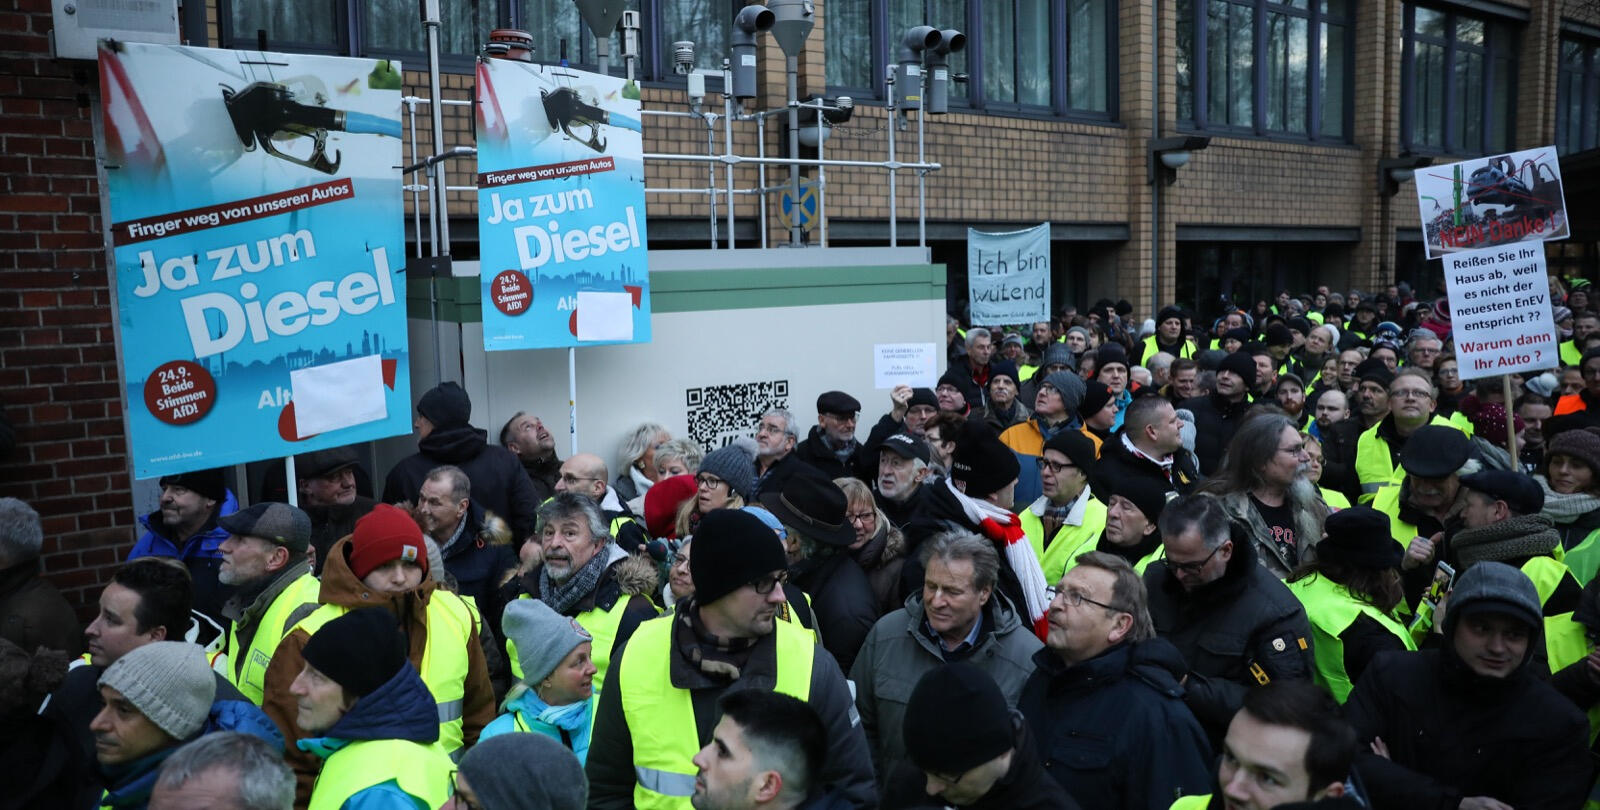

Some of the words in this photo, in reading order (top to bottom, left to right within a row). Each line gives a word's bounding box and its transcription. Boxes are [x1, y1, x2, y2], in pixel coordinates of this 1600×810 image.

[486, 171, 516, 184] Finger
[517, 170, 537, 180] weg
[538, 167, 554, 177] von
[589, 160, 612, 170] Autos
[127, 219, 182, 238] Finger
[184, 209, 220, 226] weg
[221, 206, 251, 220] von
[254, 193, 310, 214] unseren
[311, 184, 349, 201] Autos
[487, 193, 525, 224] Ja
[529, 188, 594, 217] zum
[514, 206, 641, 270] Diesel
[1440, 223, 1486, 249] NEIN
[1490, 216, 1545, 241] Danke
[1550, 211, 1556, 230] !
[133, 250, 200, 297] Ja
[206, 229, 316, 281] zum
[977, 248, 1008, 275] Ich
[1016, 248, 1047, 272] bin
[1453, 255, 1495, 269] Reißen
[1498, 252, 1516, 263] Sie
[1519, 248, 1535, 259] Ihr
[499, 273, 519, 285] 24.9.
[1455, 274, 1485, 285] Haus
[1488, 270, 1507, 280] ab,
[1513, 263, 1538, 276] weil
[497, 292, 528, 304] Stimmen
[501, 283, 520, 294] Beide
[972, 278, 1045, 303] wütend
[1464, 290, 1478, 300] es
[1480, 284, 1510, 297] nicht
[1513, 281, 1534, 292] der
[180, 247, 396, 359] Diesel
[507, 300, 522, 311] AfD!
[1457, 301, 1512, 317] neuesten
[1515, 294, 1544, 308] EnEV
[1464, 314, 1525, 331] entspricht
[1528, 310, 1541, 321] ??
[1460, 339, 1513, 354] Warum
[1516, 333, 1551, 346] dann
[1474, 358, 1493, 370] Ihr
[1497, 355, 1531, 367] Auto
[1534, 350, 1542, 362] ?
[158, 366, 191, 384] 24.9.
[162, 379, 194, 395] Beide
[156, 390, 207, 411] Stimmen
[173, 402, 199, 419] AfD!
